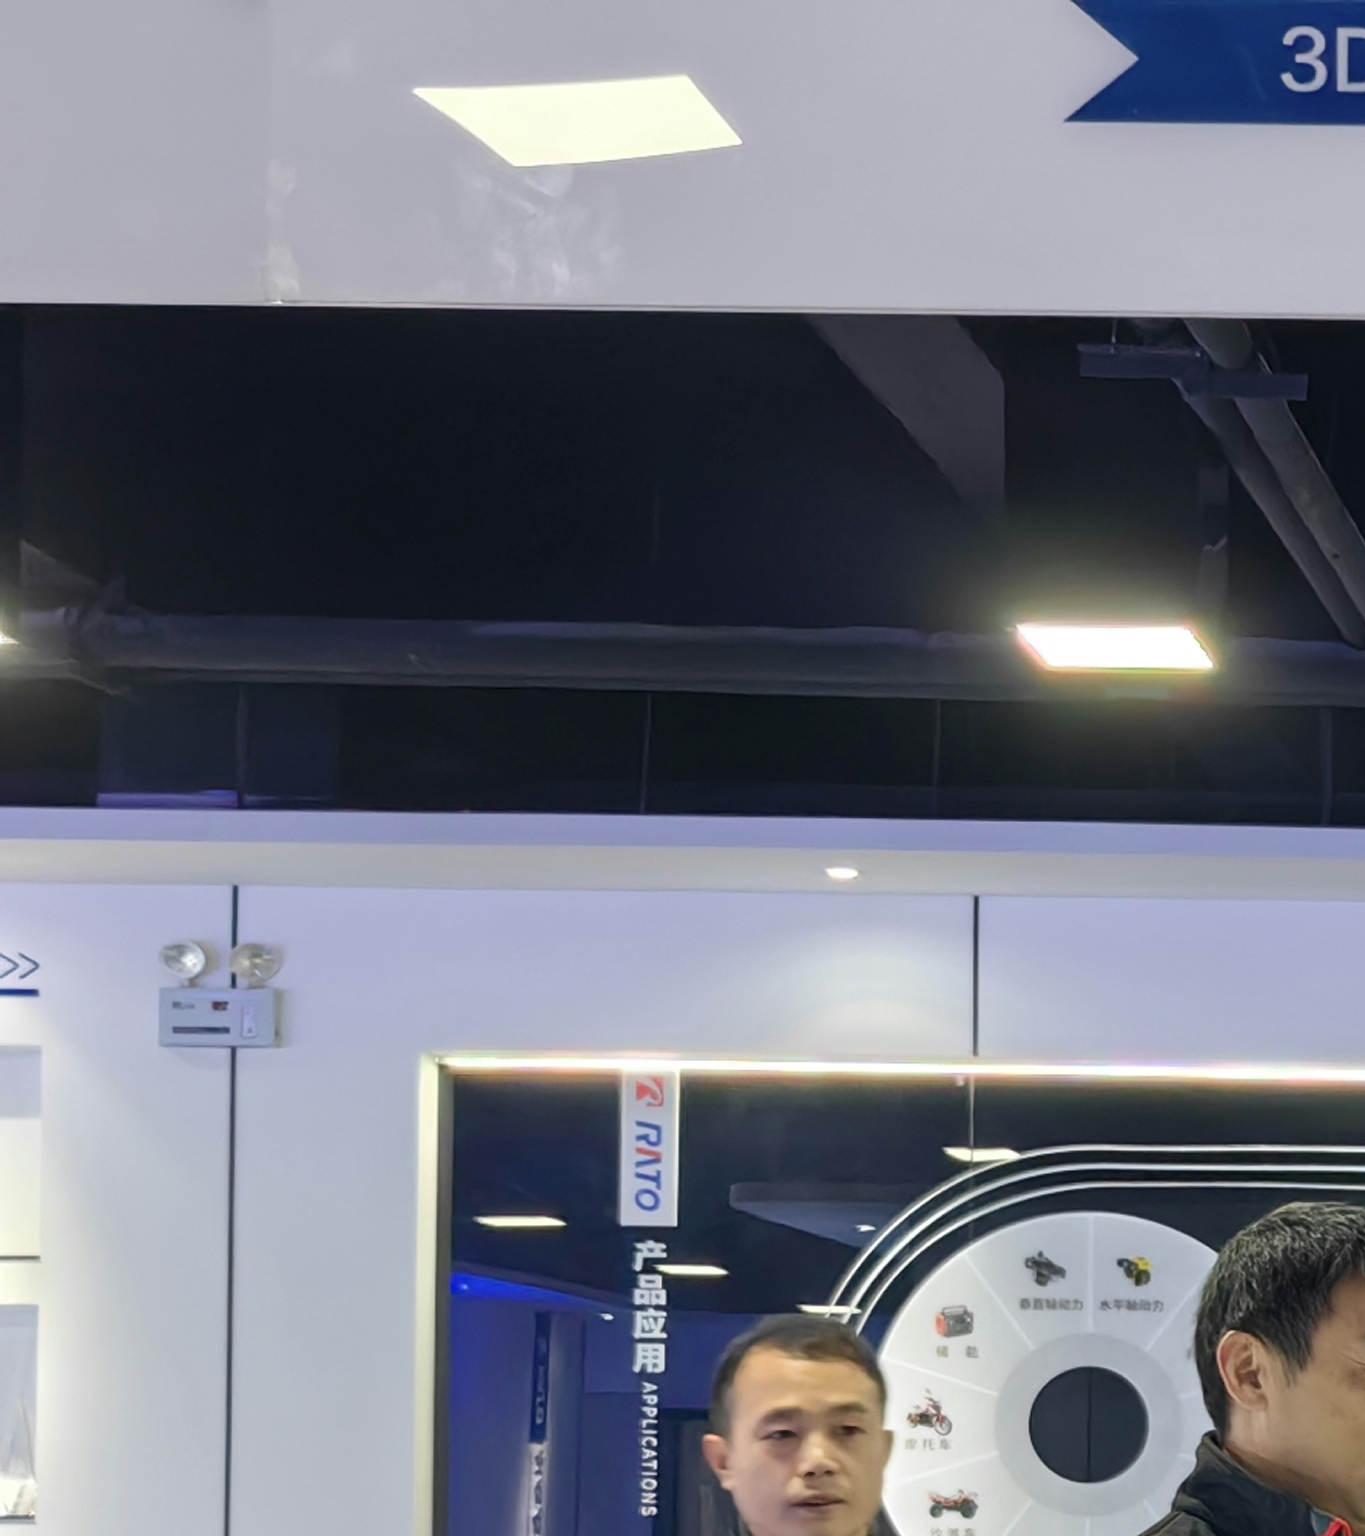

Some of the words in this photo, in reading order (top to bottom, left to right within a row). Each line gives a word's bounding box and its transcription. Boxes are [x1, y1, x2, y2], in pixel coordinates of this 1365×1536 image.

[634, 1120, 663, 1212] RATO
[632, 1239, 668, 1373] 产品应用
[640, 1381, 659, 1517] APPLICATIONS
